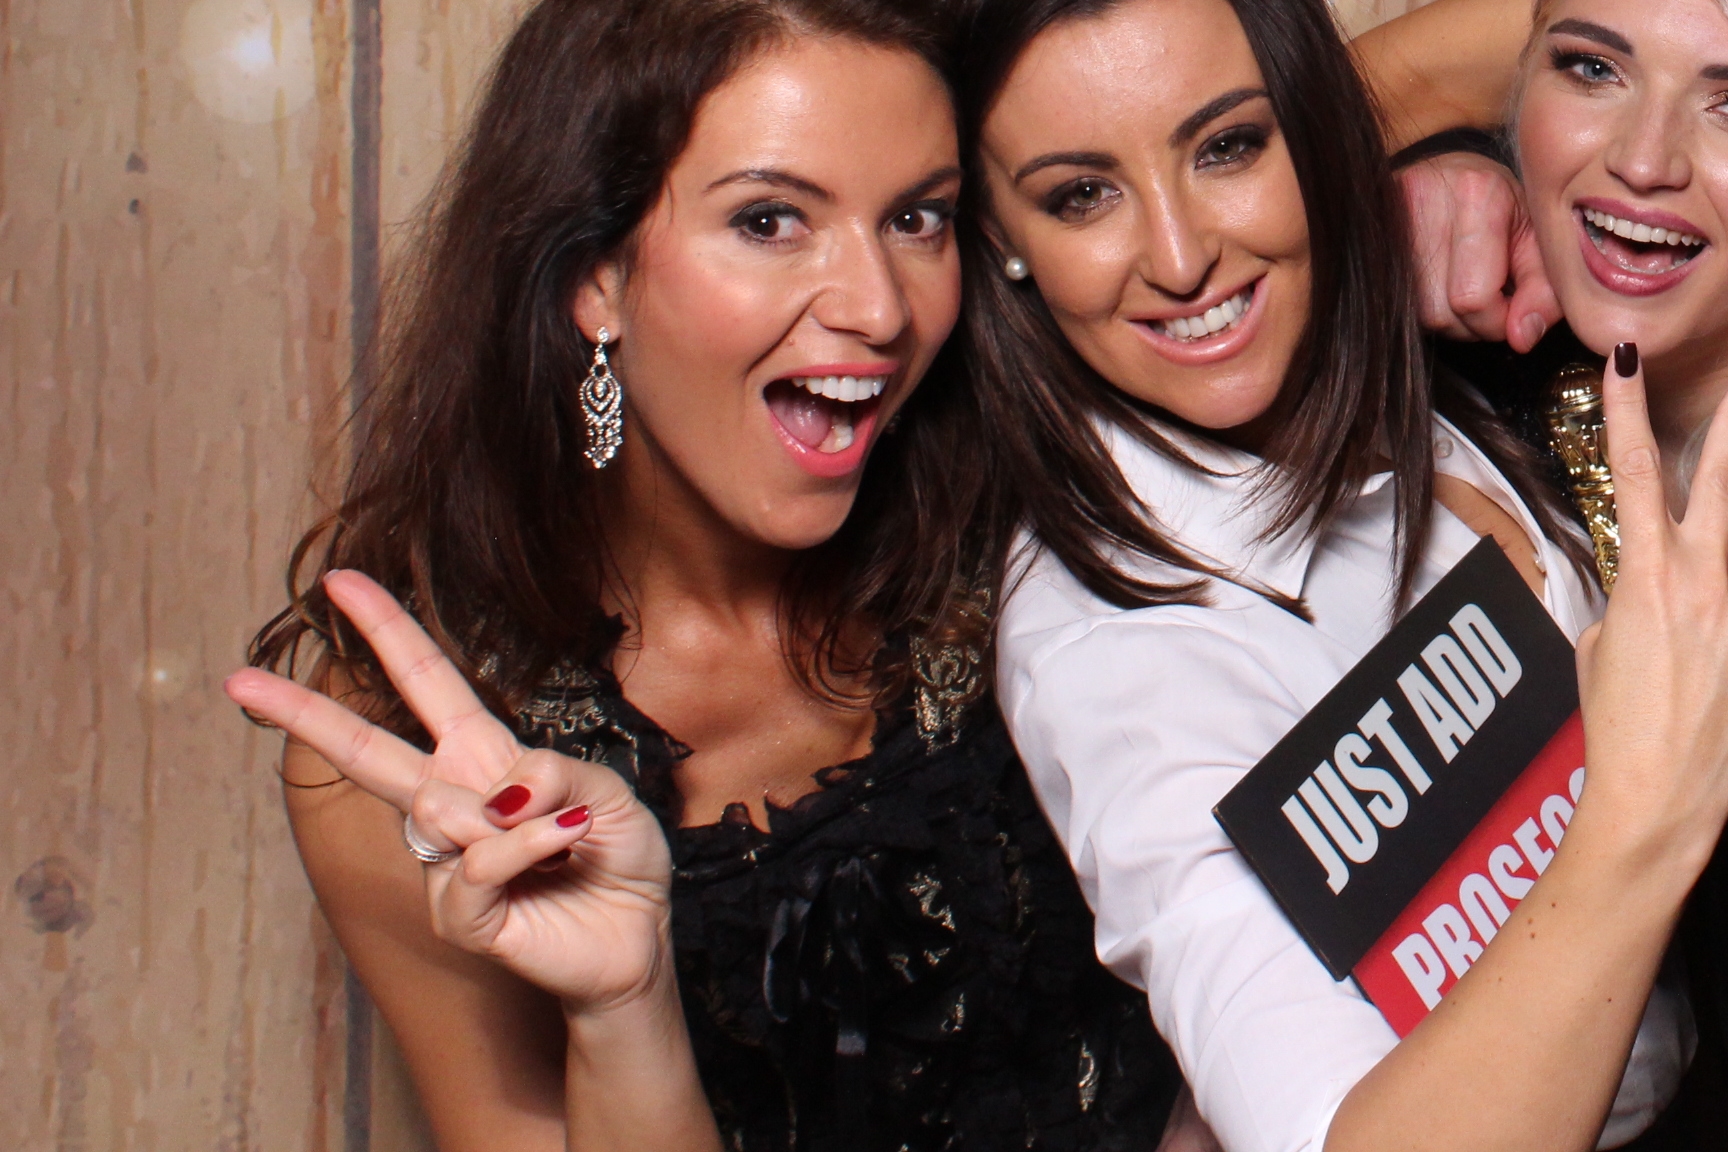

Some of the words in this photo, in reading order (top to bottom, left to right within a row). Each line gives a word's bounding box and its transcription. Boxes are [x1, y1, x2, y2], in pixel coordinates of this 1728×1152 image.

[1281, 697, 1433, 896] JUST
[1396, 603, 1523, 764] ADD
[1391, 766, 1585, 1011] PROSE
